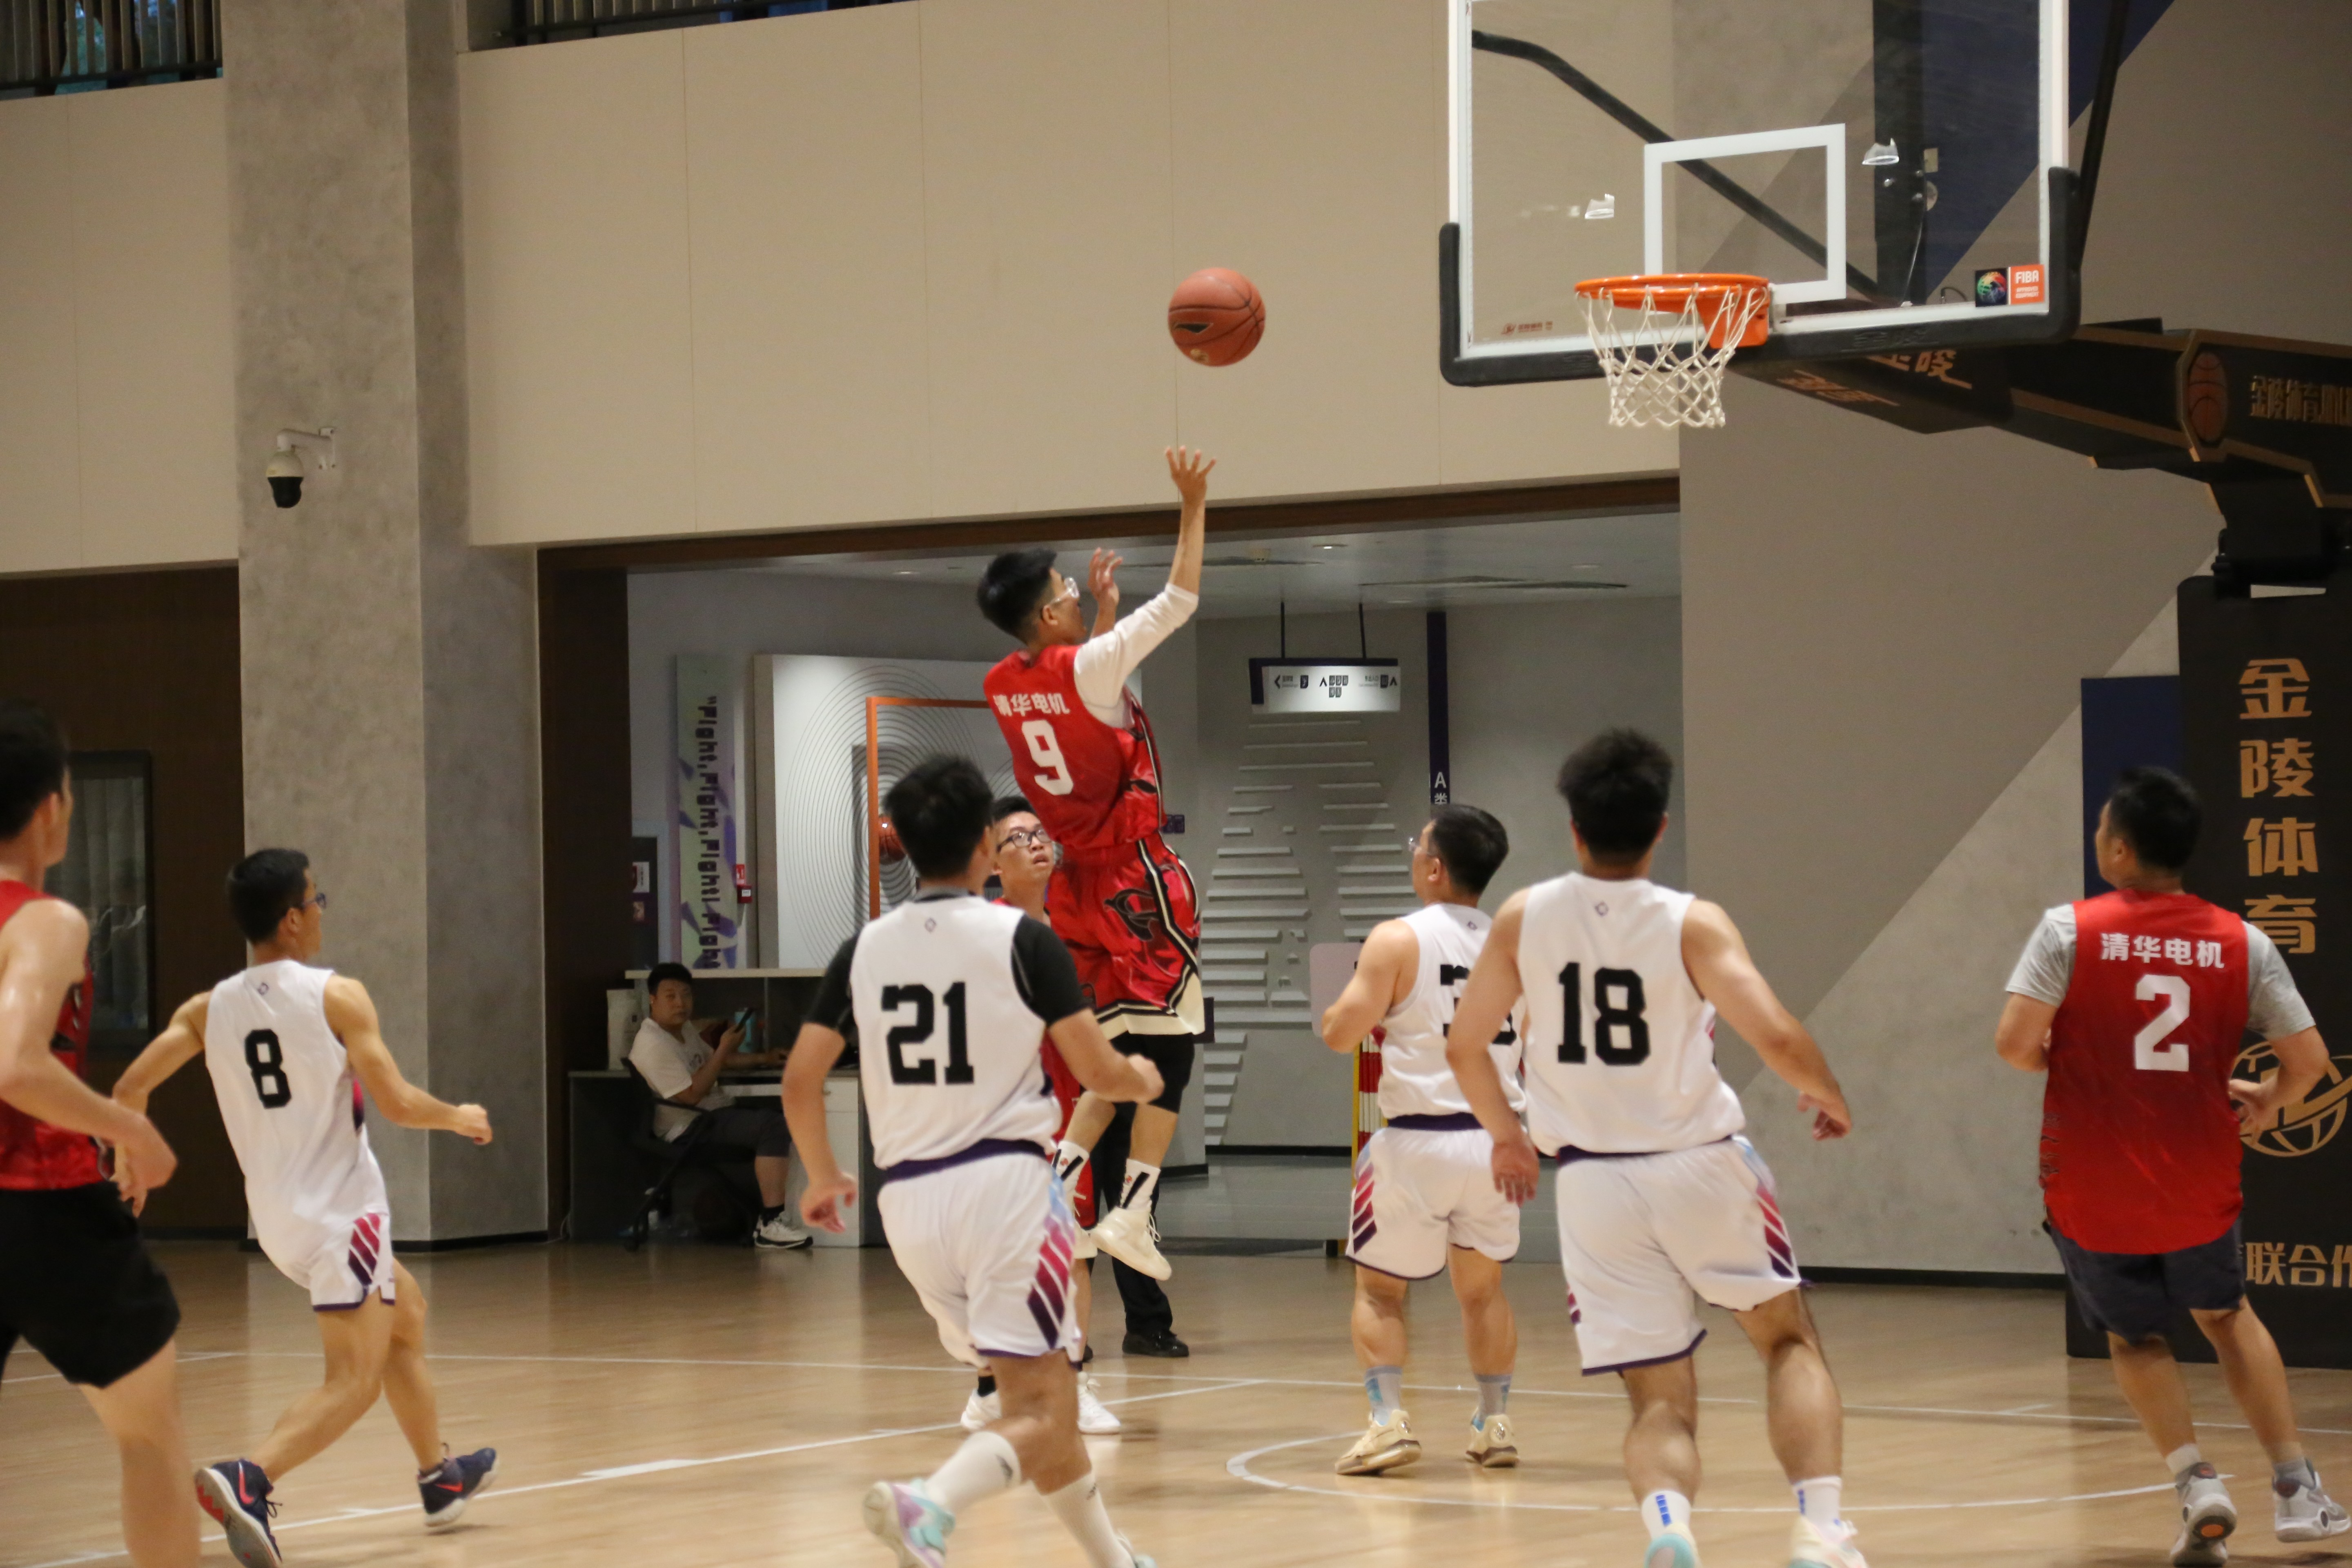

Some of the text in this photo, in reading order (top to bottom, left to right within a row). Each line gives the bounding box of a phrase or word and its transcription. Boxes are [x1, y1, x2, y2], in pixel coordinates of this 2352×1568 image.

[2016, 270, 2039, 284] FIBA
[993, 693, 1071, 717] 清华电机
[1021, 719, 1074, 796] 9
[2239, 658, 2319, 954] 金陵体育
[2100, 933, 2225, 969] 清华电机
[881, 982, 974, 1085] 21
[1557, 962, 1651, 1066] 18
[2134, 974, 2191, 1072] 2
[244, 1029, 292, 1109] 8
